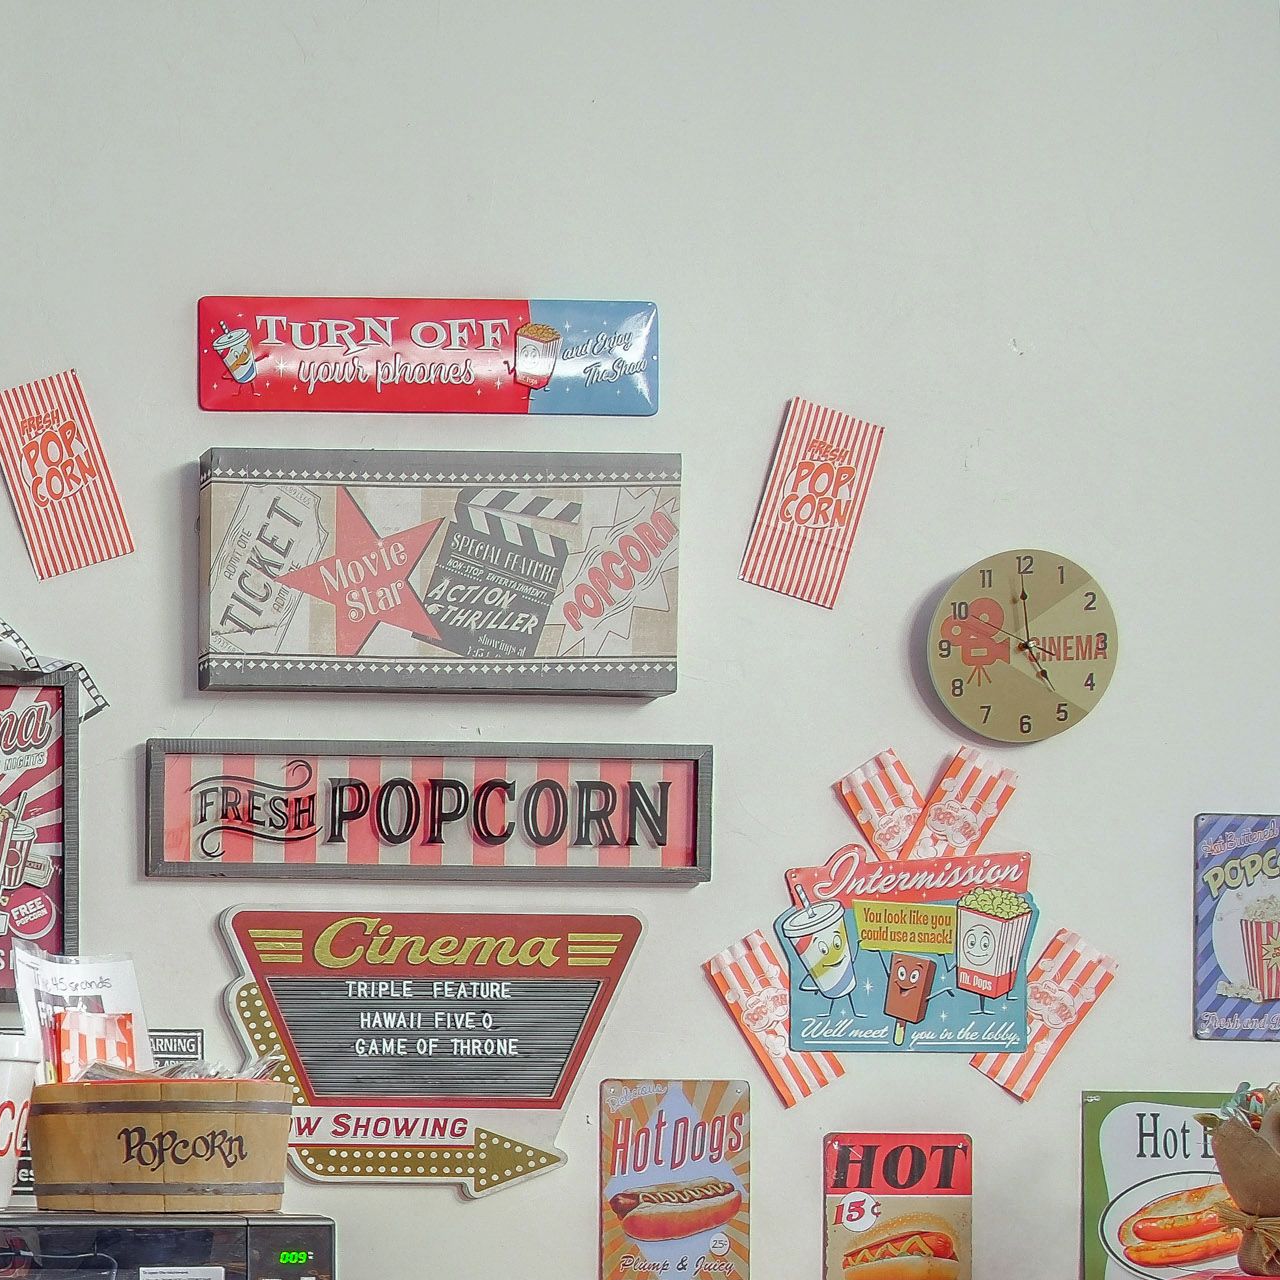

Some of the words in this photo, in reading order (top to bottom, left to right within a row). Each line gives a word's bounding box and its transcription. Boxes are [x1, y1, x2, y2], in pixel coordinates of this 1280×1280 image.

[254, 315, 400, 357] TURN
[408, 317, 512, 351] OFF
[562, 338, 590, 361] and
[591, 330, 634, 355] Enjoy
[298, 355, 368, 395] your
[374, 354, 475, 394] phones
[583, 361, 611, 388] The
[608, 357, 648, 383] Show
[20, 408, 60, 437] FRESH
[21, 419, 78, 478] POP
[806, 438, 850, 463] FRESH
[31, 449, 98, 508] CORN
[791, 461, 856, 499] POP
[778, 493, 852, 528] CORN
[219, 496, 304, 636] TICKET
[224, 548, 243, 581] ADMIT
[240, 527, 253, 551] ONE
[319, 536, 409, 597] Movie
[450, 532, 502, 566] SPECIAL
[503, 551, 559, 585] FEATURE
[1016, 555, 1034, 575] 12
[446, 558, 484, 577] NON-STOP
[485, 572, 549, 600] ENTERTAINMENT!
[562, 510, 680, 632] POPCORN
[979, 569, 993, 589] 11
[1057, 566, 1065, 585] 1
[344, 582, 406, 623] Star
[426, 578, 518, 608] ACTION
[1083, 591, 1097, 611] 2
[440, 604, 539, 635] THRILLER
[951, 602, 969, 621] 10
[477, 633, 517, 655] showings
[515, 647, 528, 657] at
[938, 639, 951, 659] 9
[1027, 634, 1108, 663] CINEMA
[1095, 632, 1108, 652] 3
[951, 678, 964, 698] 8
[1083, 672, 1096, 691] 4
[979, 705, 992, 724] 7
[1019, 714, 1032, 734] 6
[1056, 703, 1068, 722] 5
[4, 751, 45, 772] NIGHTS
[198, 785, 317, 830] FRESH
[323, 777, 673, 848] POPCORN
[1201, 836, 1226, 858] Hot
[1225, 819, 1280, 850] Buttered
[813, 850, 1024, 900] Intermission
[10, 896, 45, 920] FREE
[15, 907, 48, 928] POPCORN
[864, 908, 881, 925] You
[883, 909, 906, 925] look
[909, 910, 929, 926] like
[931, 915, 952, 930] you
[313, 917, 563, 968] Cinema
[861, 929, 888, 941] could
[890, 931, 907, 942] use
[909, 933, 916, 942] a
[918, 930, 953, 944] snack!
[68, 975, 113, 992] seconds
[345, 980, 414, 998] TRIPLE
[432, 981, 512, 998] FEATURE
[972, 974, 992, 991] Pops
[360, 1012, 421, 1029] HAWAII
[434, 1012, 476, 1029] FIVE
[848, 1023, 889, 1038] meet
[1201, 1011, 1241, 1030] Fresh
[1242, 1012, 1269, 1030] and
[354, 1038, 408, 1056] GAME
[416, 1038, 439, 1055] OF
[450, 1038, 519, 1056] THRONE
[911, 1028, 938, 1046] you
[939, 1029, 954, 1041] in
[956, 1021, 980, 1041] the
[981, 1022, 1021, 1048] lobby.
[606, 1082, 669, 1113] Delicious
[329, 1112, 469, 1139] SHOWING
[1136, 1112, 1191, 1160] Hot
[610, 1110, 668, 1177] Hot
[670, 1111, 745, 1170] Dogs
[831, 1144, 968, 1190] HOT
[619, 1254, 671, 1274] Plump
[676, 1256, 689, 1271] &
[694, 1254, 736, 1276] Juicy
